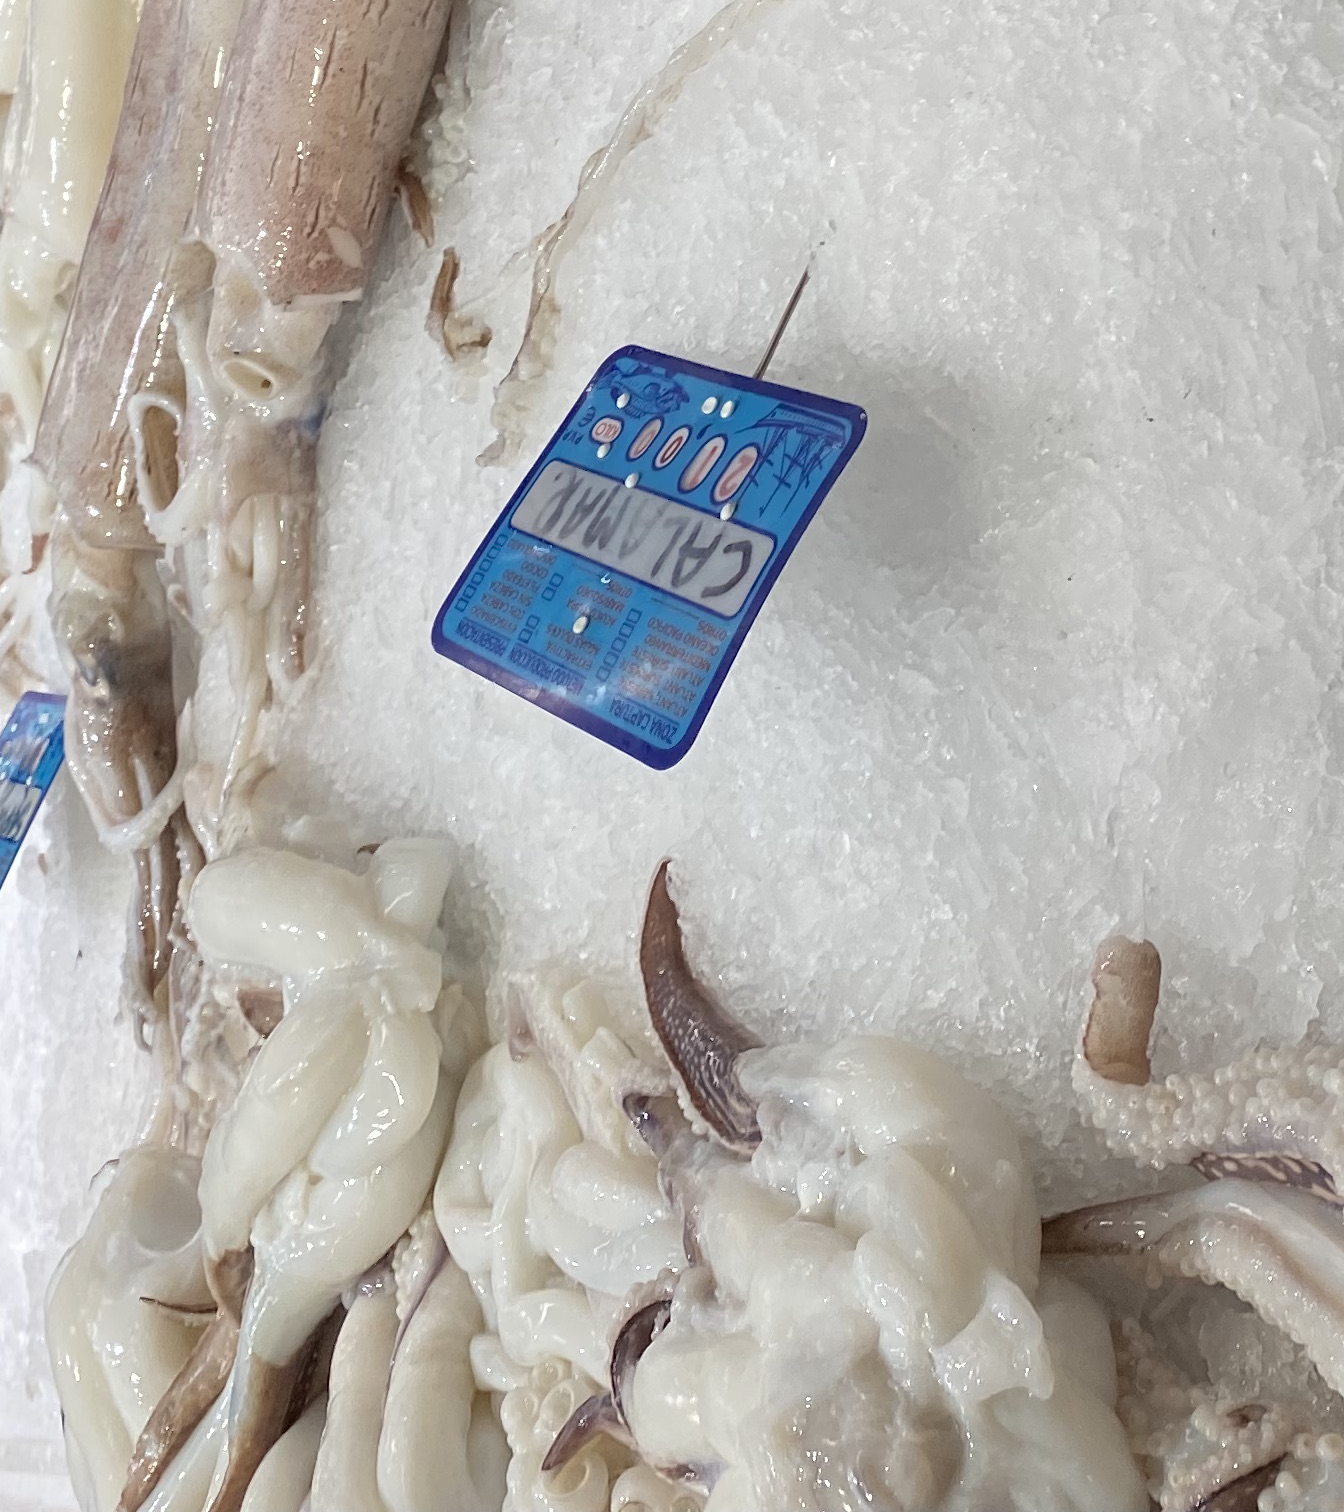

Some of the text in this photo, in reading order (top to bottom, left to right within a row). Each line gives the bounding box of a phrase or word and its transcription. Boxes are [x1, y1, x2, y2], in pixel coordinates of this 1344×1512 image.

[576, 406, 597, 428] €
[593, 421, 621, 441] KILO
[693, 620, 728, 643] OTROS
[608, 699, 679, 744] ZONA CAPTURA
